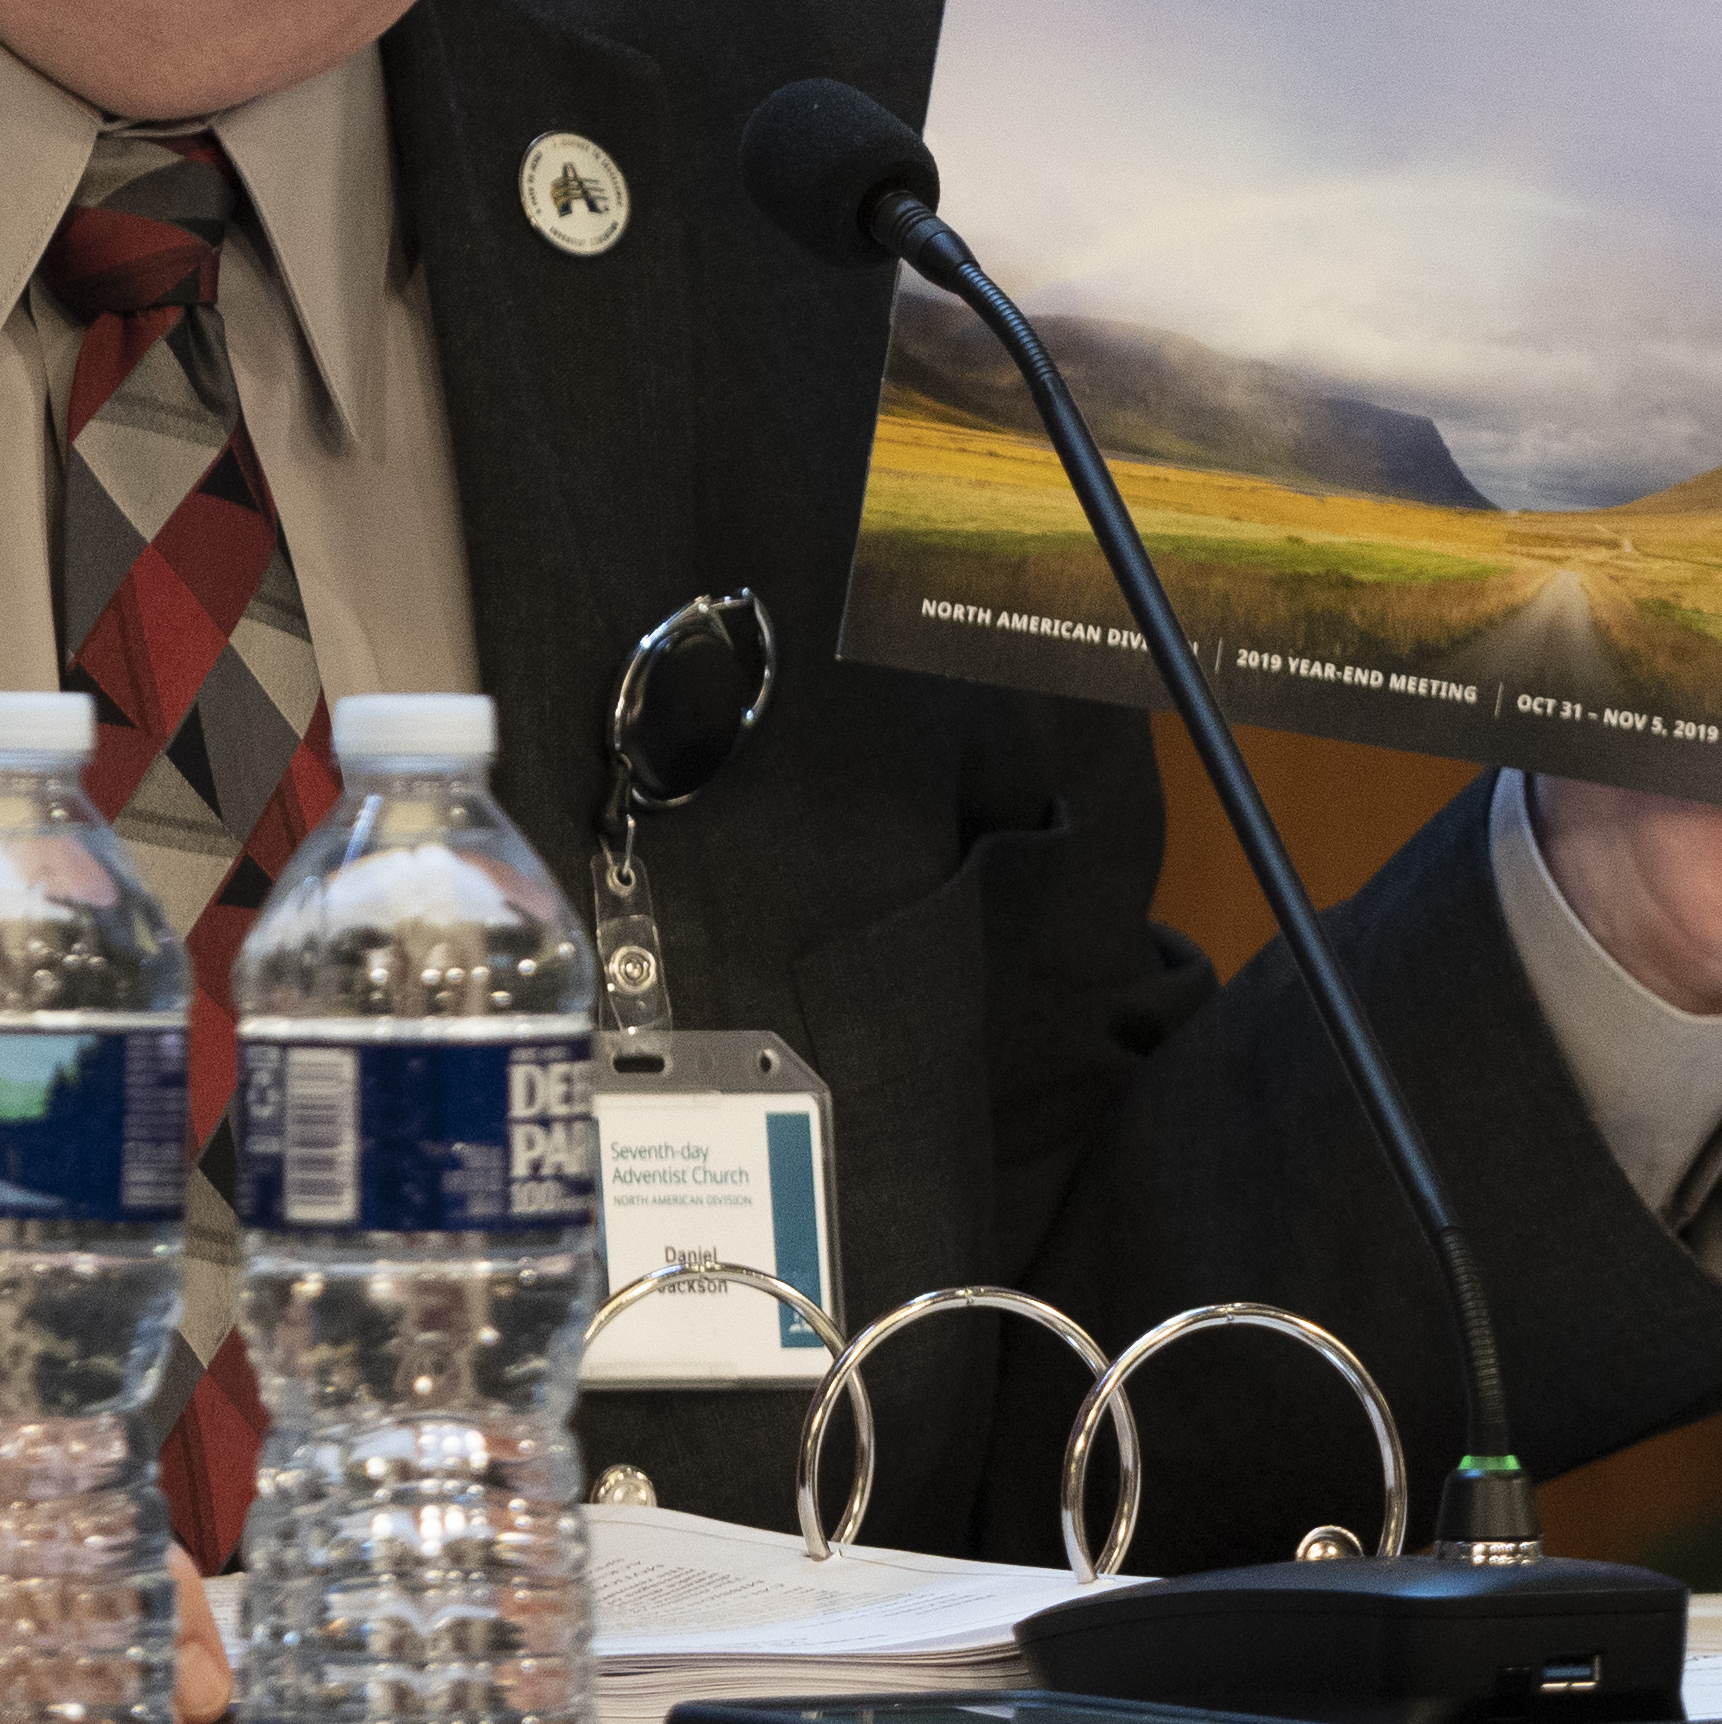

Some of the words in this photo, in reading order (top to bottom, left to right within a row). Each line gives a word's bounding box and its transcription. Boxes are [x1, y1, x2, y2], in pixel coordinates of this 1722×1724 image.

[922, 598, 992, 626] NORTH
[996, 610, 1101, 645] AMERICAN
[1107, 628, 1198, 656] DIVI
[1236, 648, 1282, 672] 2019
[1288, 656, 1384, 689] YEAR-END
[1388, 672, 1477, 704] MEETING
[1517, 693, 1557, 716] OCT
[1560, 700, 1583, 721] 31
[1603, 707, 1648, 732] NOV
[1651, 715, 1668, 738] 5,
[1673, 719, 1719, 744] 2019
[610, 1141, 709, 1163] Seventh-day
[612, 1167, 687, 1185] Adventist
[692, 1165, 750, 1185] Church
[614, 1195, 648, 1206] NORTH
[651, 1195, 704, 1206] AMERICAN
[706, 1195, 753, 1206] DIVISION
[664, 1245, 718, 1264] Daniel
